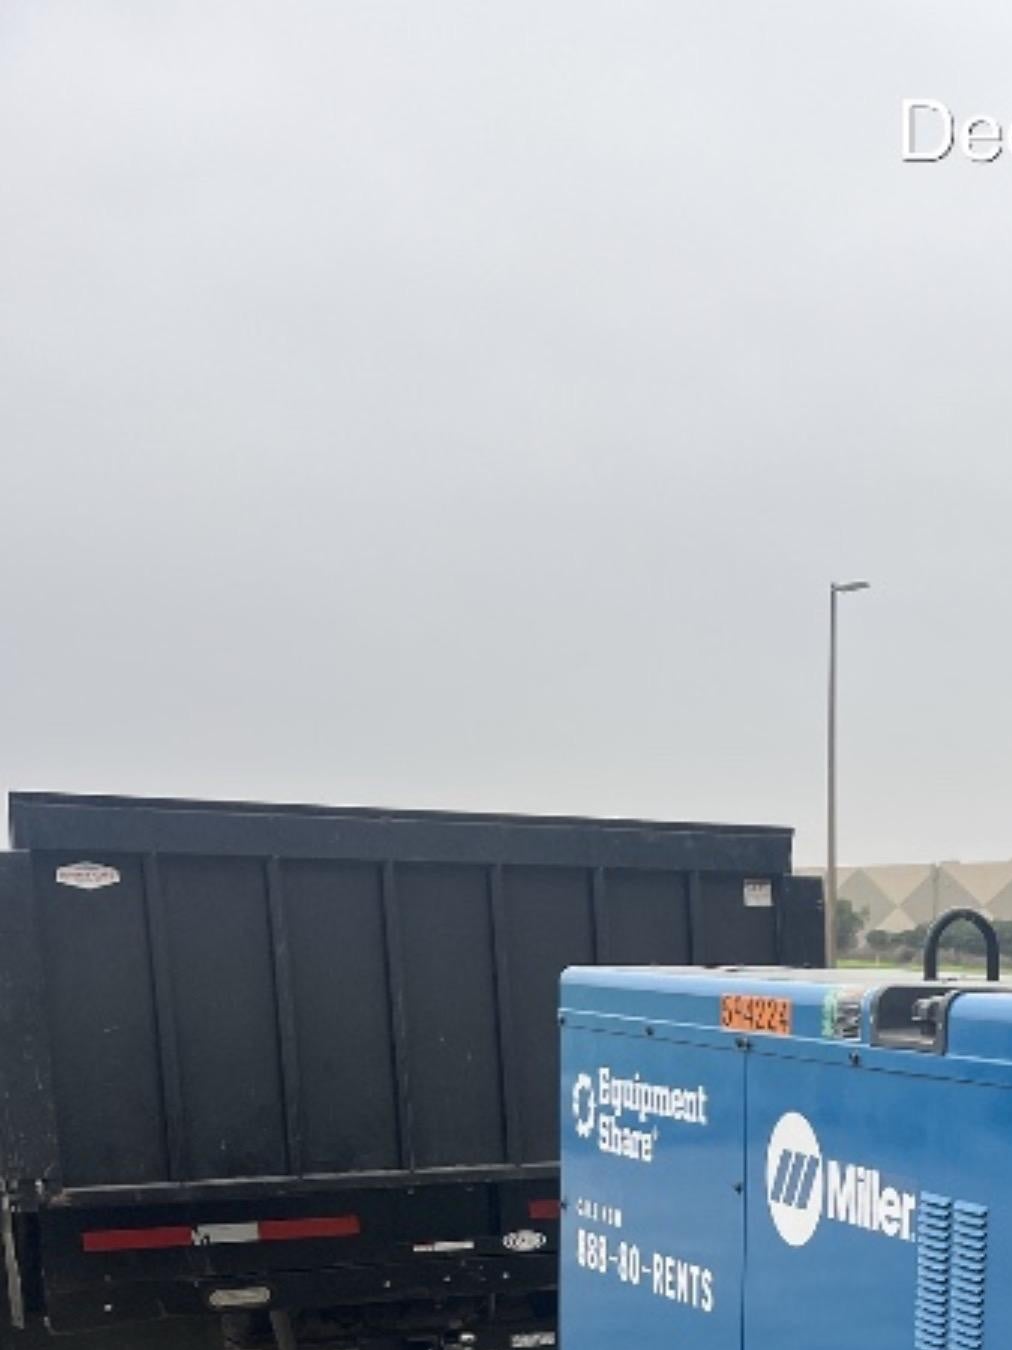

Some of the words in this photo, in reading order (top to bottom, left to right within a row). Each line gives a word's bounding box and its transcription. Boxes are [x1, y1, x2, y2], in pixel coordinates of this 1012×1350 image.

[599, 1067, 708, 1126] Equipment
[599, 1112, 653, 1162] Share
[826, 1158, 916, 1242] Miller
